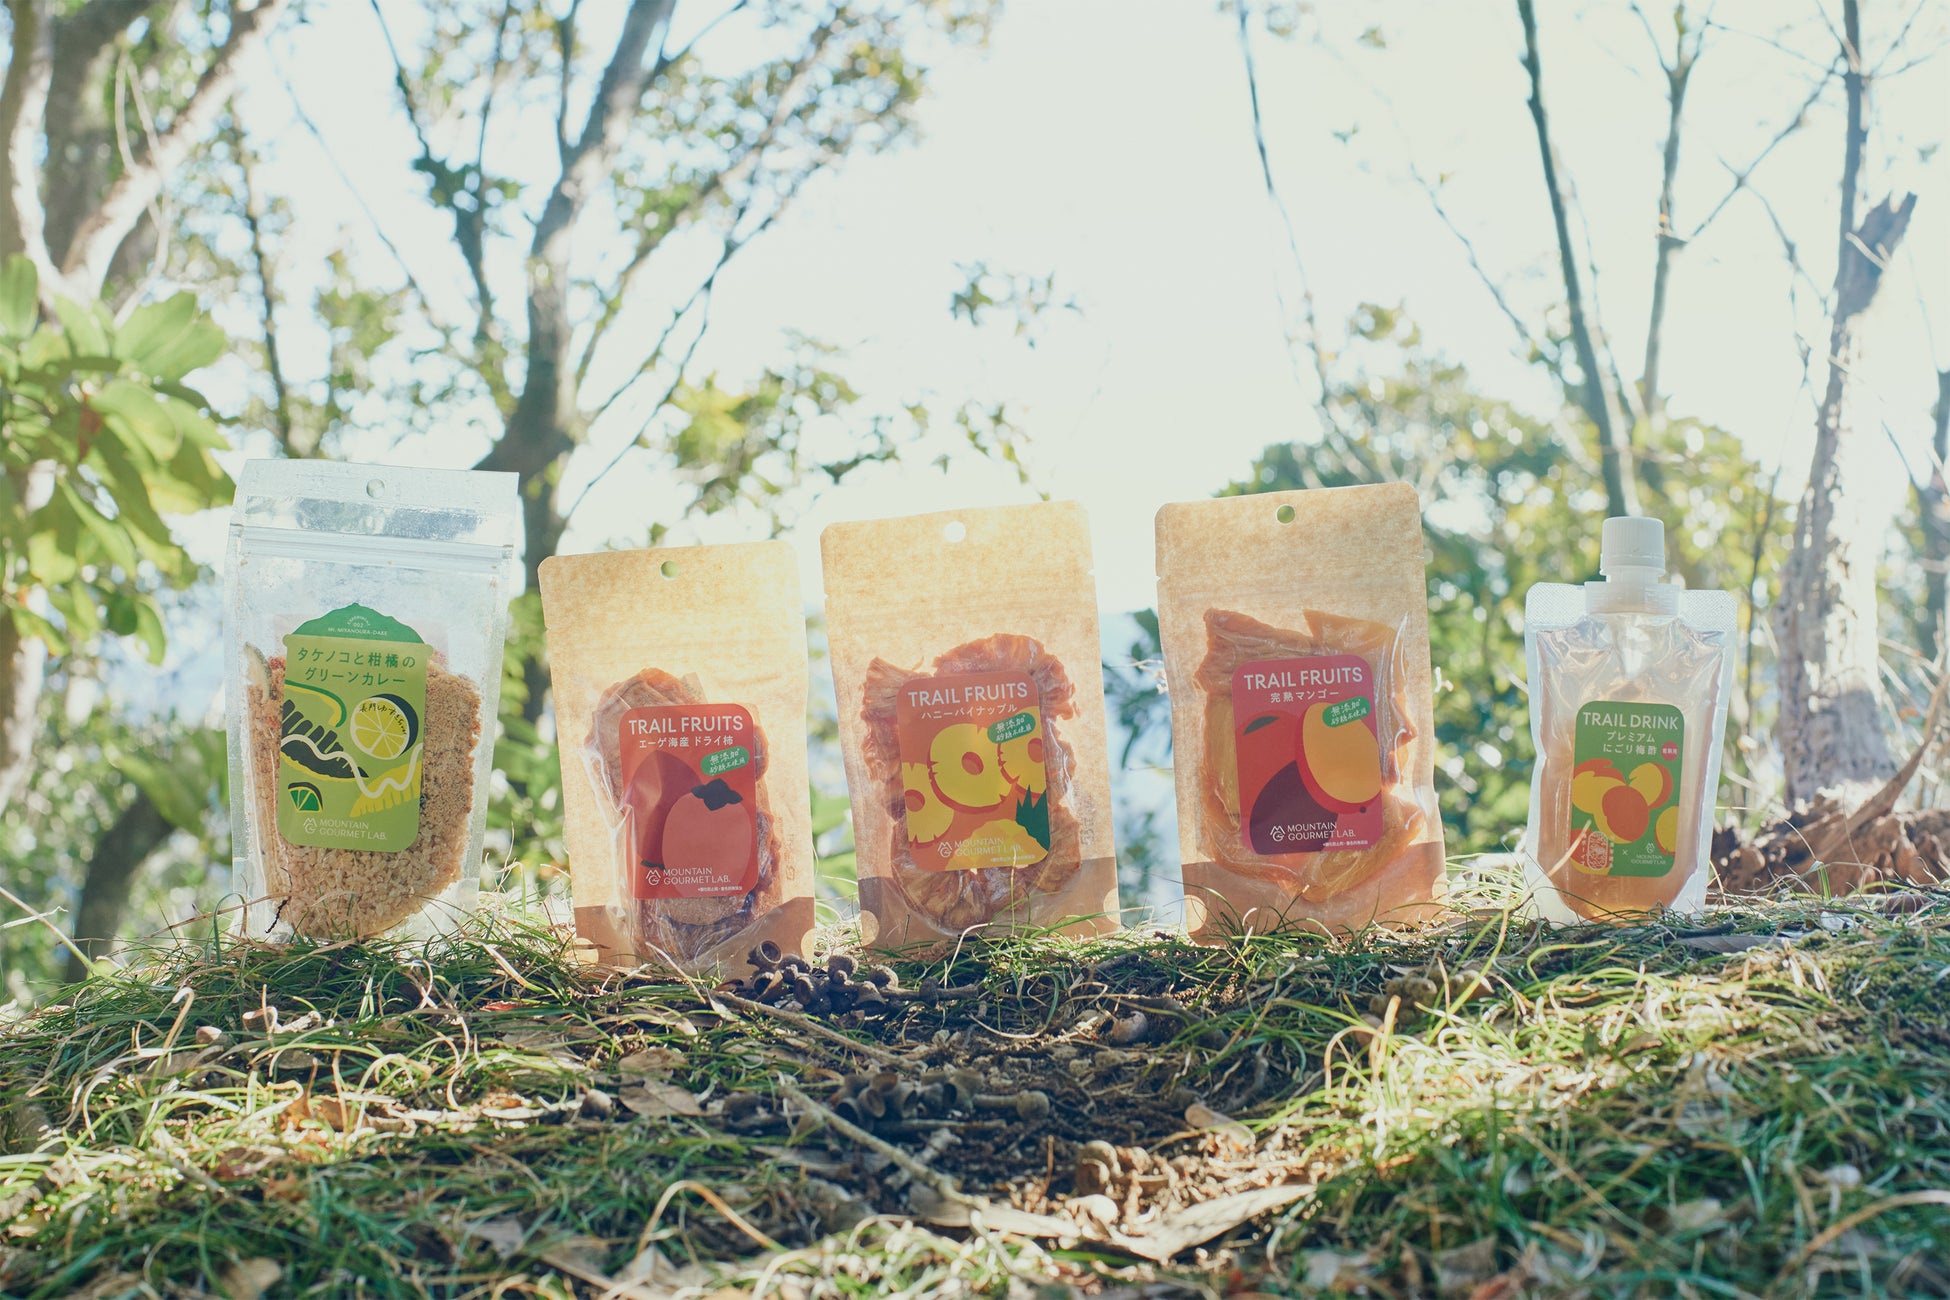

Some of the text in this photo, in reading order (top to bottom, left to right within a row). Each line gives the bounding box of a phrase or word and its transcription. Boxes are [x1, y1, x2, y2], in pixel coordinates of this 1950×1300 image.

[298, 647, 416, 669] タケノコと柑橘の
[304, 667, 406, 686] グリーンカレー
[1242, 666, 1363, 690] TRAIL FRUITS
[908, 681, 1028, 707] TRAIL FRUITS
[1270, 688, 1340, 703] 完熟マンゴー
[921, 703, 1018, 720] ハニーパイナップル
[628, 715, 743, 735] TRAIL FRUITS
[1582, 711, 1679, 730] TRAIL DRINK
[1606, 730, 1656, 743] プレミアム
[319, 819, 369, 830] MOUNTAIN
[1287, 822, 1338, 833] MOUNTAIN
[319, 828, 366, 839] GOURMET
[1287, 829, 1356, 841] GOURMET LAB.
[954, 838, 1005, 848] MOUNTAIN
[954, 847, 1002, 857] GOURMET
[663, 867, 713, 877] MOUNTAIN
[663, 874, 731, 885] GOURMET LAB.
